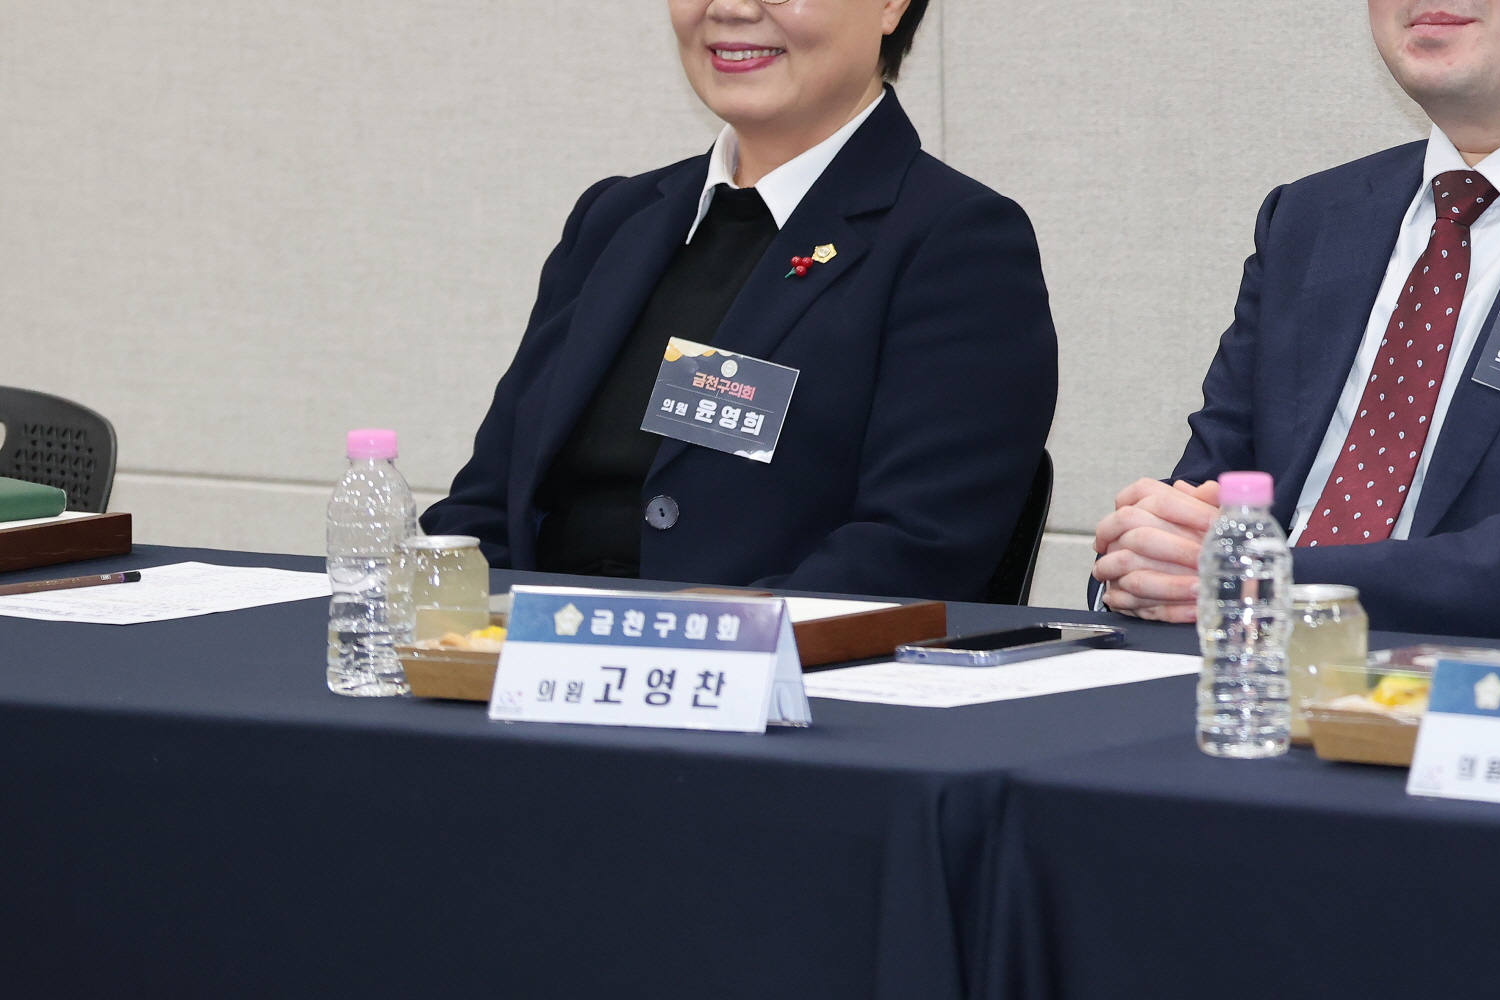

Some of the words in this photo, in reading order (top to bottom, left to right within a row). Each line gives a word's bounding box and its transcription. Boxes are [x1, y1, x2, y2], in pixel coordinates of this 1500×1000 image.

[692, 372, 756, 401] 금천구의회
[661, 398, 689, 416] 의원
[694, 398, 765, 436] 윤영희
[590, 608, 741, 642] 금천구의회
[536, 679, 584, 704] 의원
[594, 666, 726, 709] 고영찬
